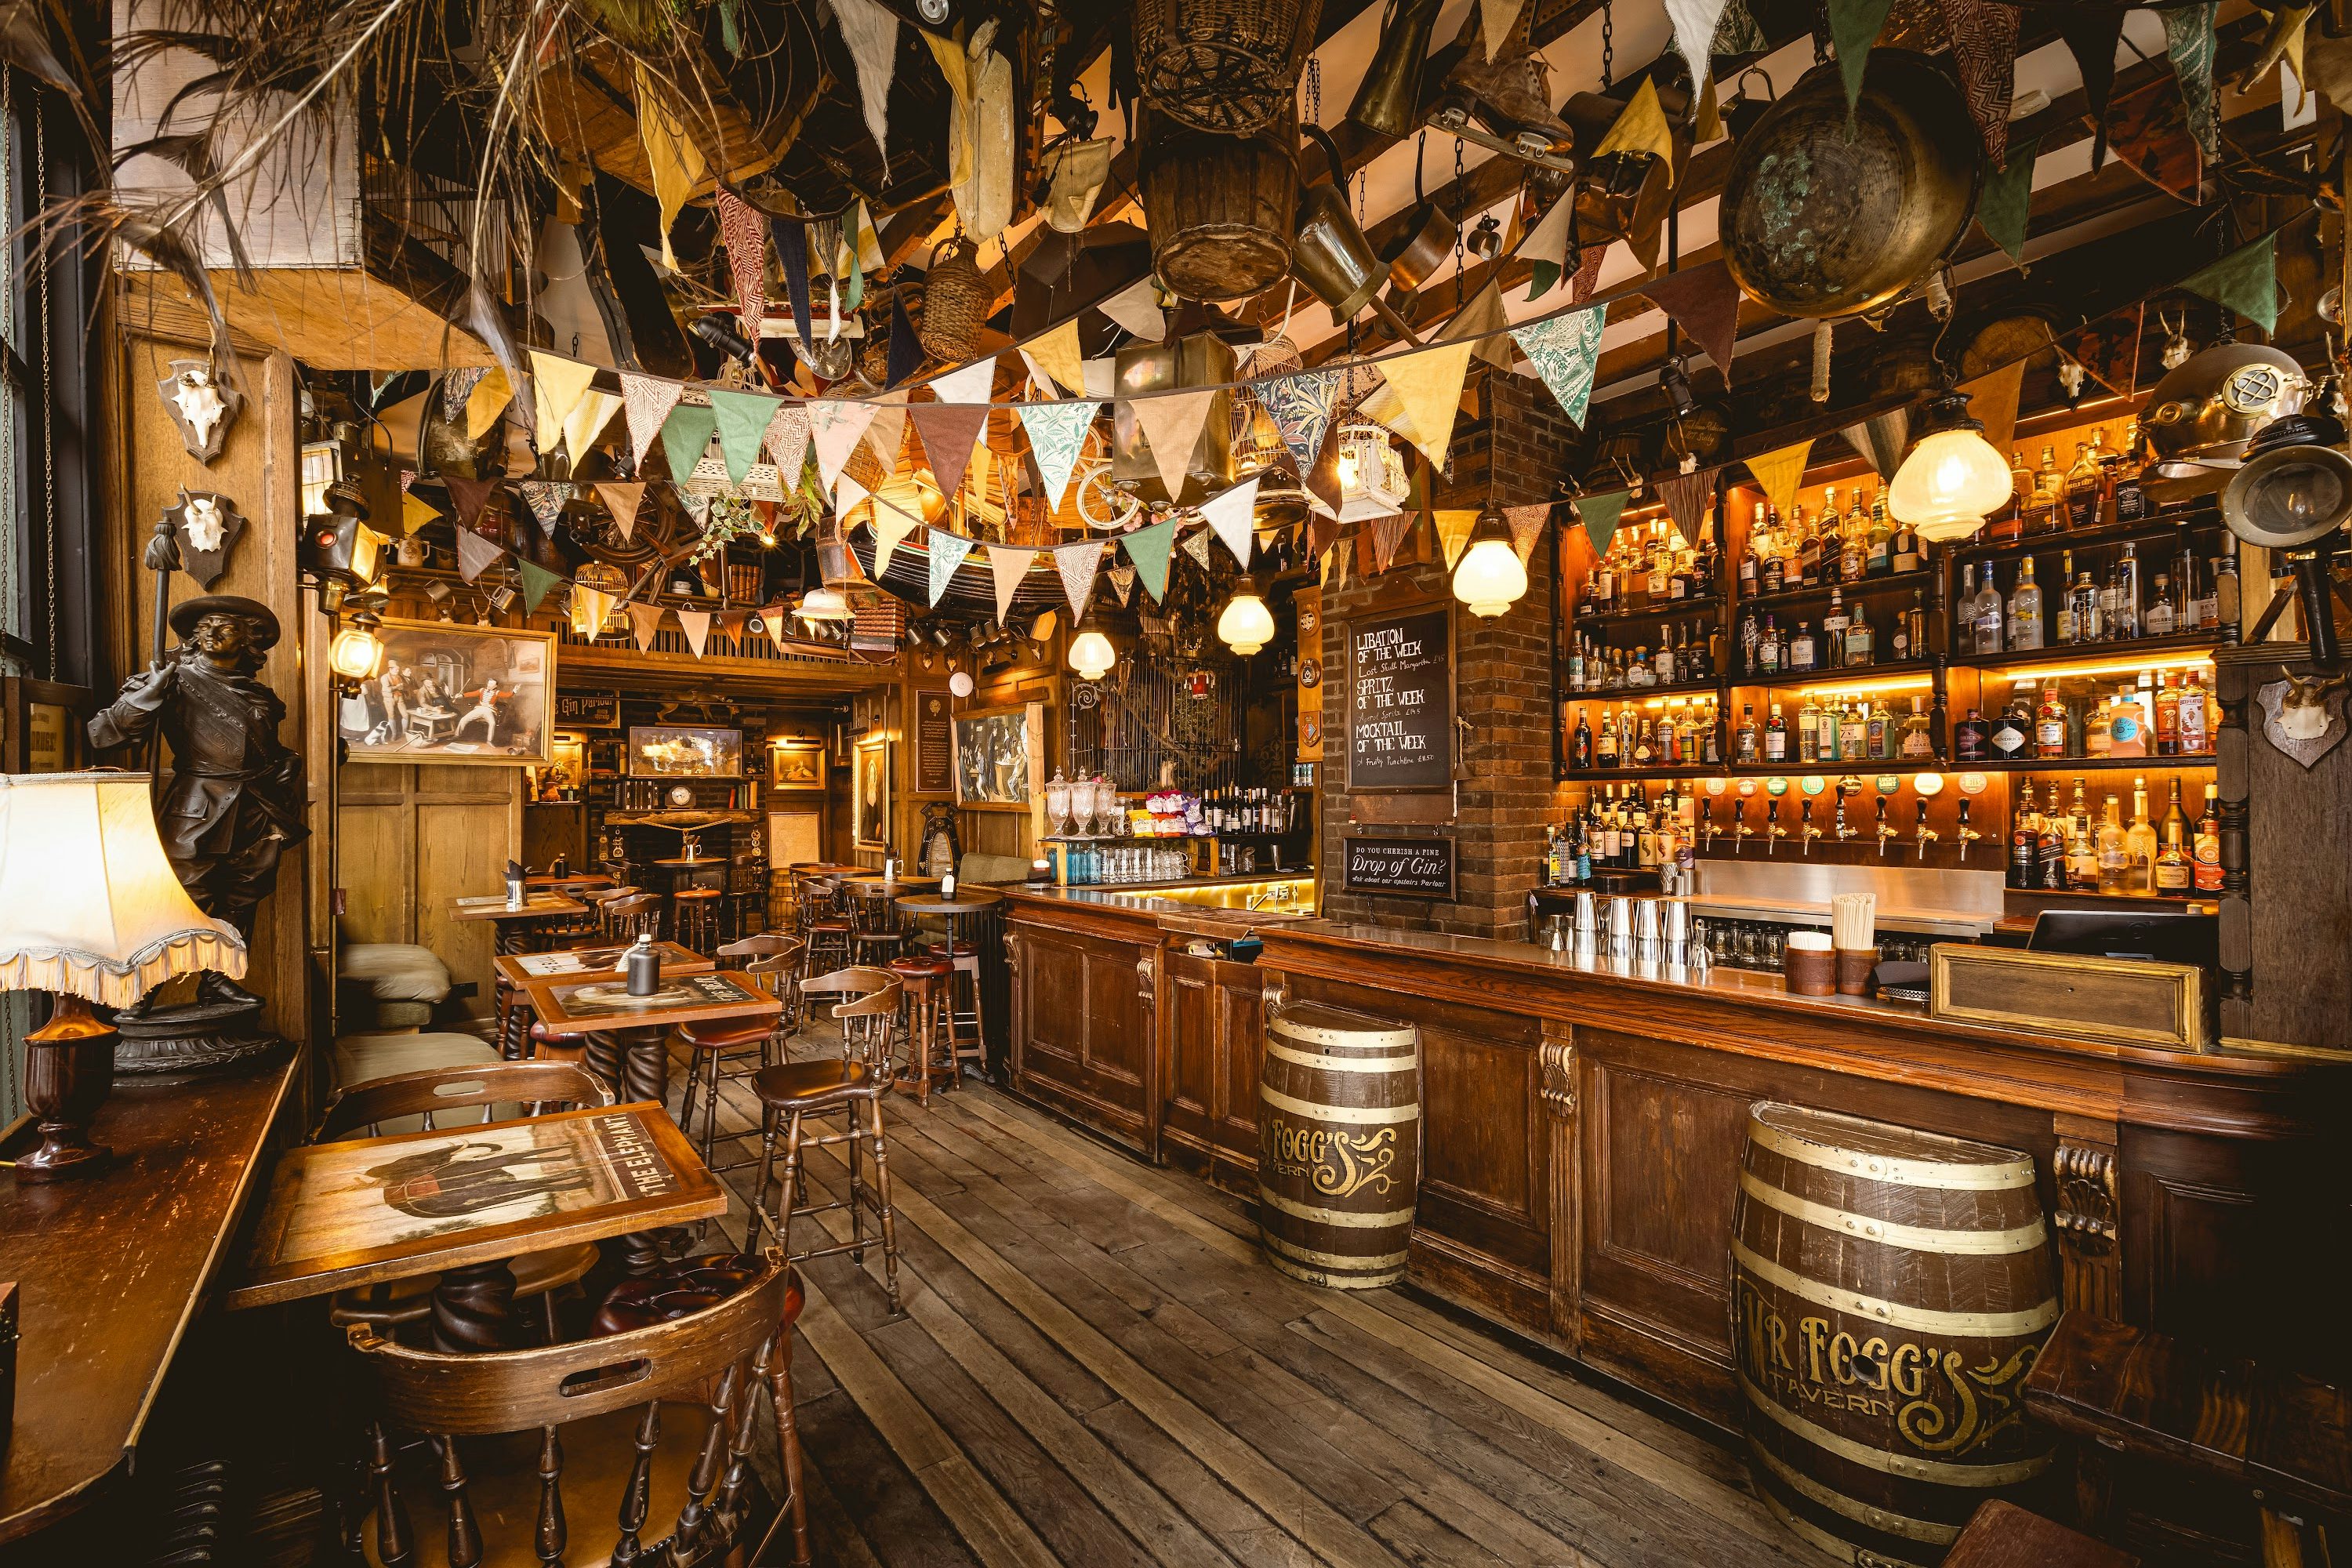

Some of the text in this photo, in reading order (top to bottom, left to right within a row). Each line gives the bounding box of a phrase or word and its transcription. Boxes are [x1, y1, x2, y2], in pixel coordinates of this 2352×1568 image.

[1356, 628, 1403, 651] LIBATION
[1357, 640, 1422, 663] OF THE WEEK
[1359, 666, 1377, 677] Lost
[1380, 661, 1397, 673] Skull
[1356, 676, 1394, 696] SPRITZ
[561, 698, 579, 717] Gin
[1357, 689, 1425, 710] OF THE WEEK
[1356, 720, 1407, 739] MOCKTAIL
[1357, 735, 1427, 753] OF THE WEEK
[1352, 855, 1446, 877] Drop of Gin?
[604, 1116, 666, 1192] THE ELEPHANT
[1272, 1119, 1356, 1196] FOGG'S
[1743, 1291, 1978, 1451] MR FOGG'S
[1768, 1370, 1895, 1416] TAVERN
